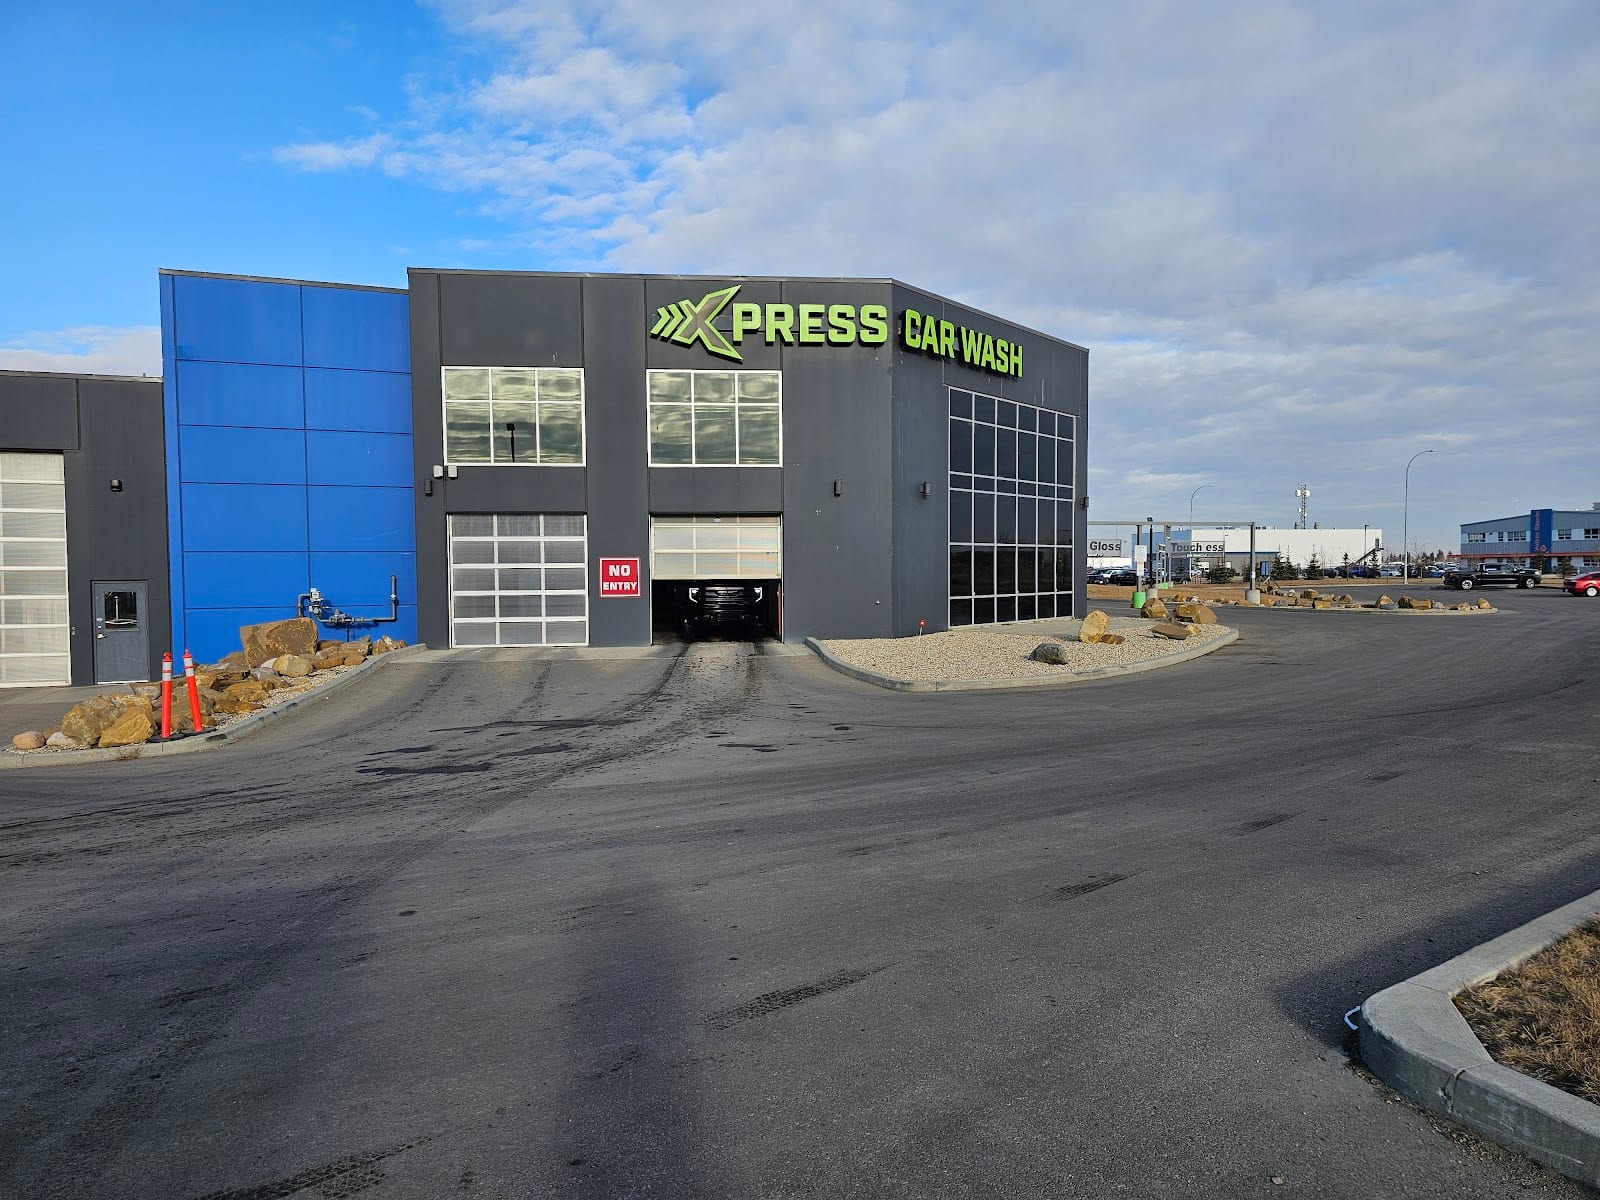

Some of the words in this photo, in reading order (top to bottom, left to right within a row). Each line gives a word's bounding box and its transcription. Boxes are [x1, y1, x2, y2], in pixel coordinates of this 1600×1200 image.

[904, 308, 956, 359] CAR
[960, 325, 1023, 378] WASH
[1089, 541, 1121, 551] Gloss
[608, 564, 631, 577] NO
[602, 581, 638, 591] ENTRY
